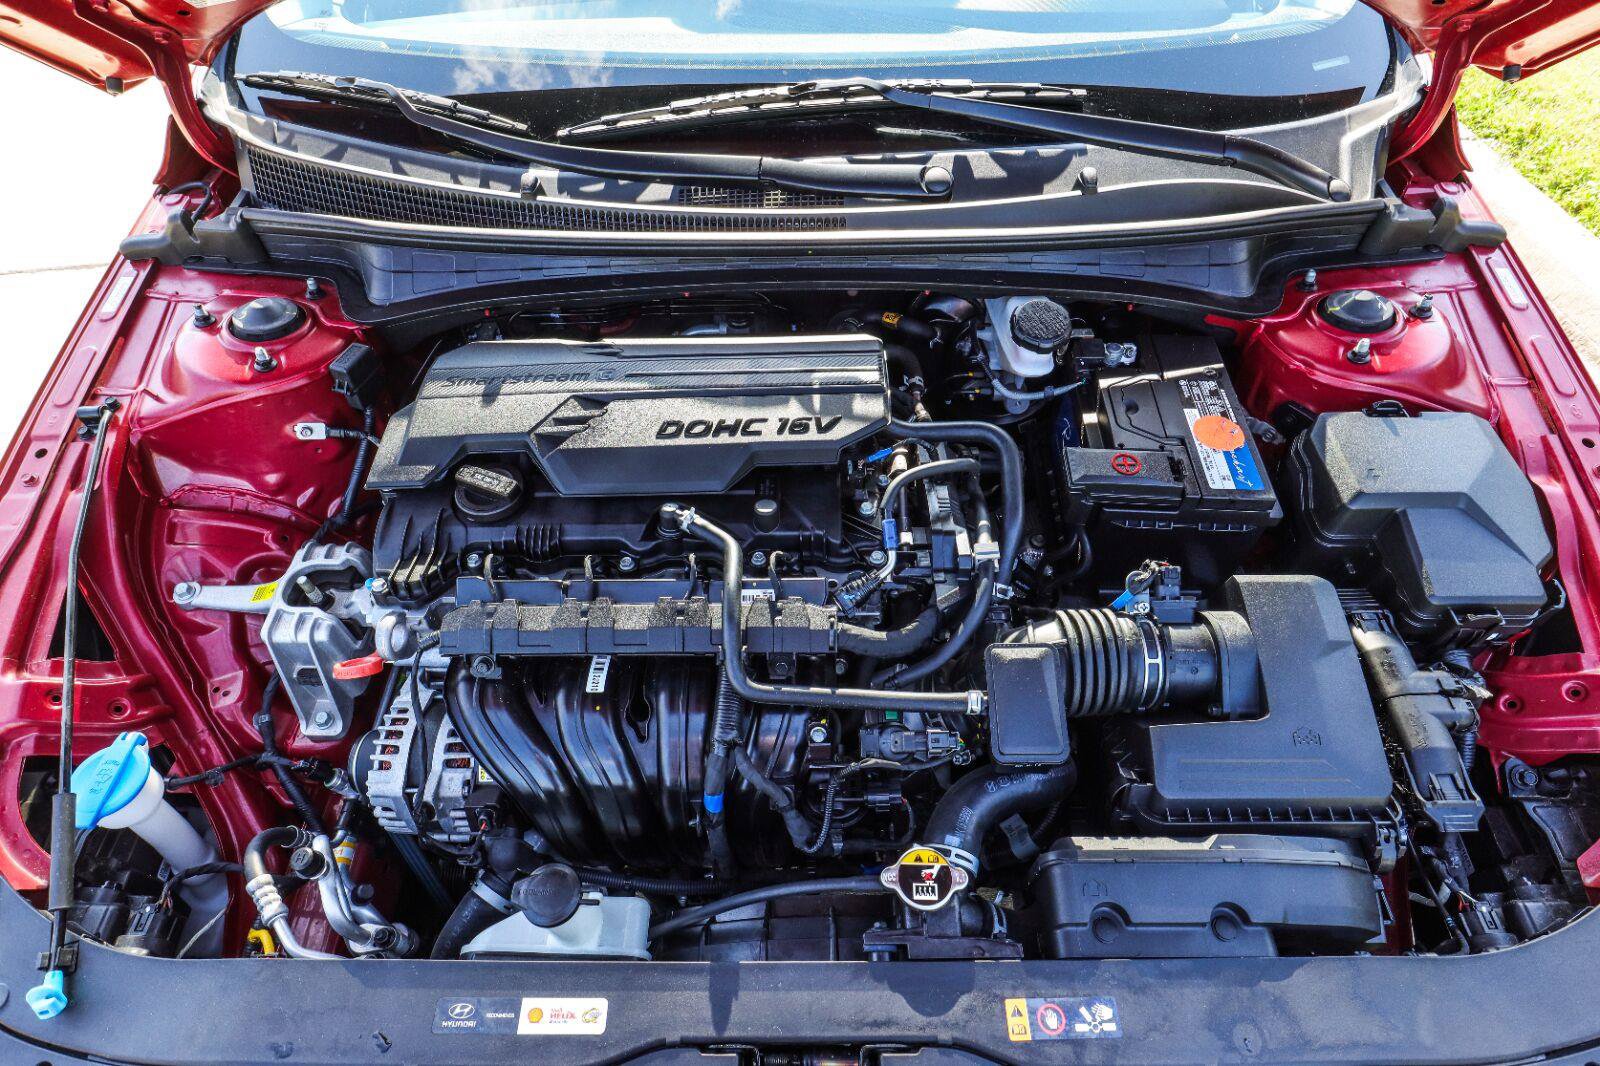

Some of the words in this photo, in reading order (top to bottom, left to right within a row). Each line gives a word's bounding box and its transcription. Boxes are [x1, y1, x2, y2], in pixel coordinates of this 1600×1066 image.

[445, 372, 591, 387] Smartstream
[655, 418, 769, 440] DOHC
[776, 415, 843, 436] 16V
[441, 1020, 477, 1028] HYUNDAI
